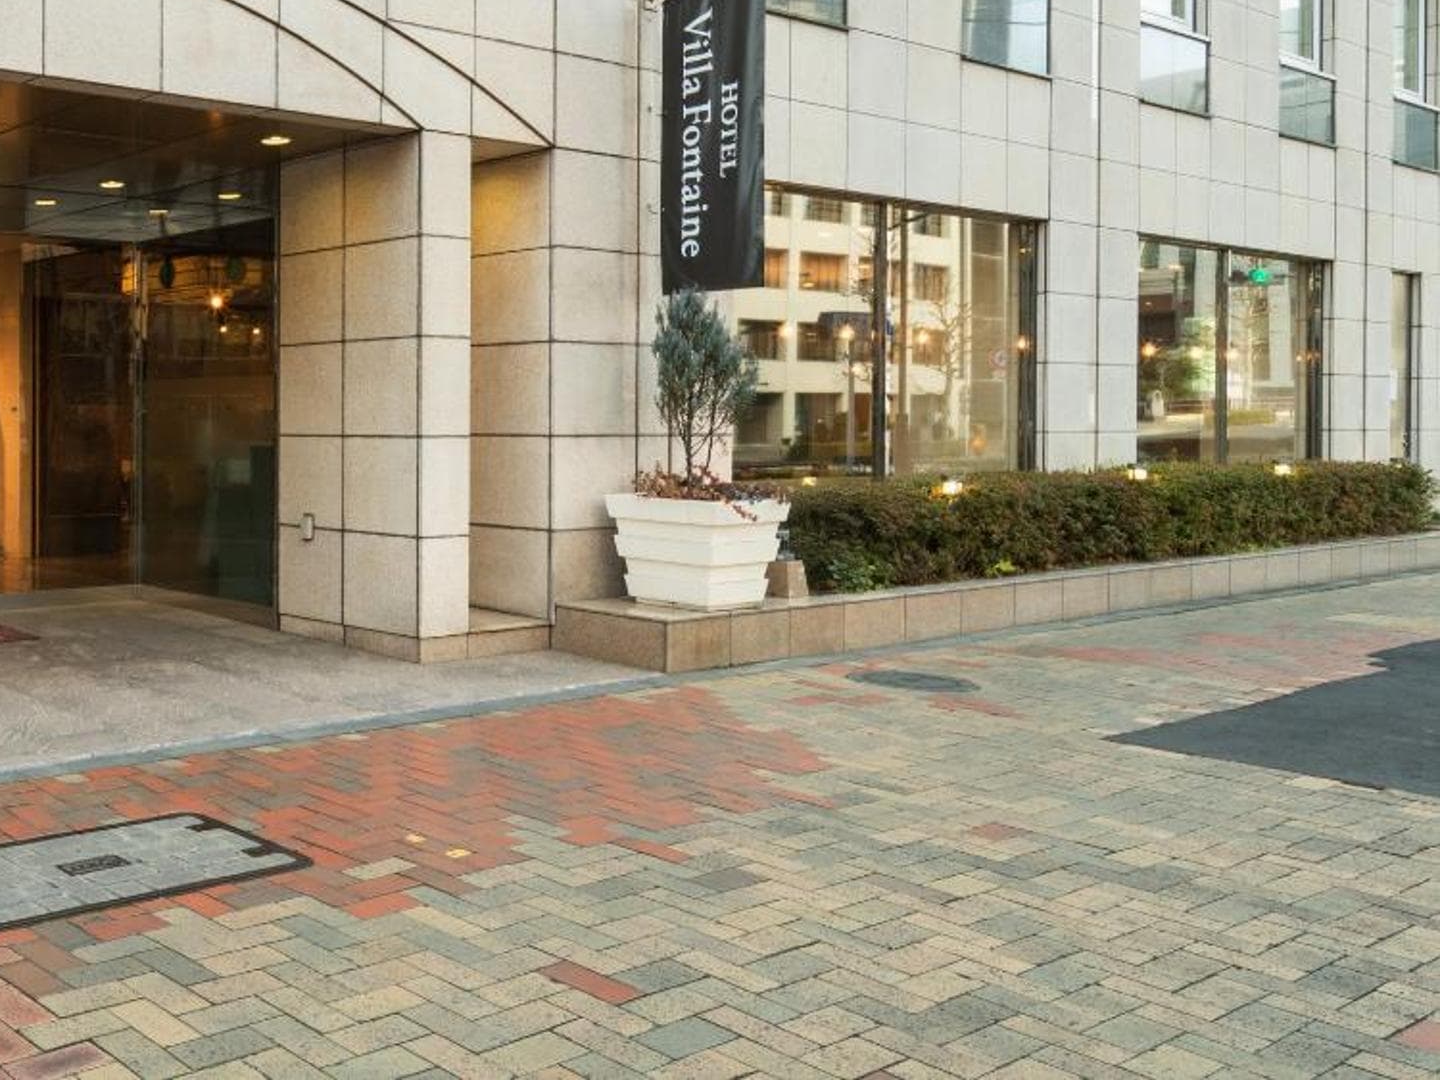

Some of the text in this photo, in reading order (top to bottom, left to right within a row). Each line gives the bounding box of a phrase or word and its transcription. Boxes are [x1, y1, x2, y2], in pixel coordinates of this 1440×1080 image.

[681, 7, 714, 257] Villa Fontaine
[719, 81, 738, 178] HOTEL
